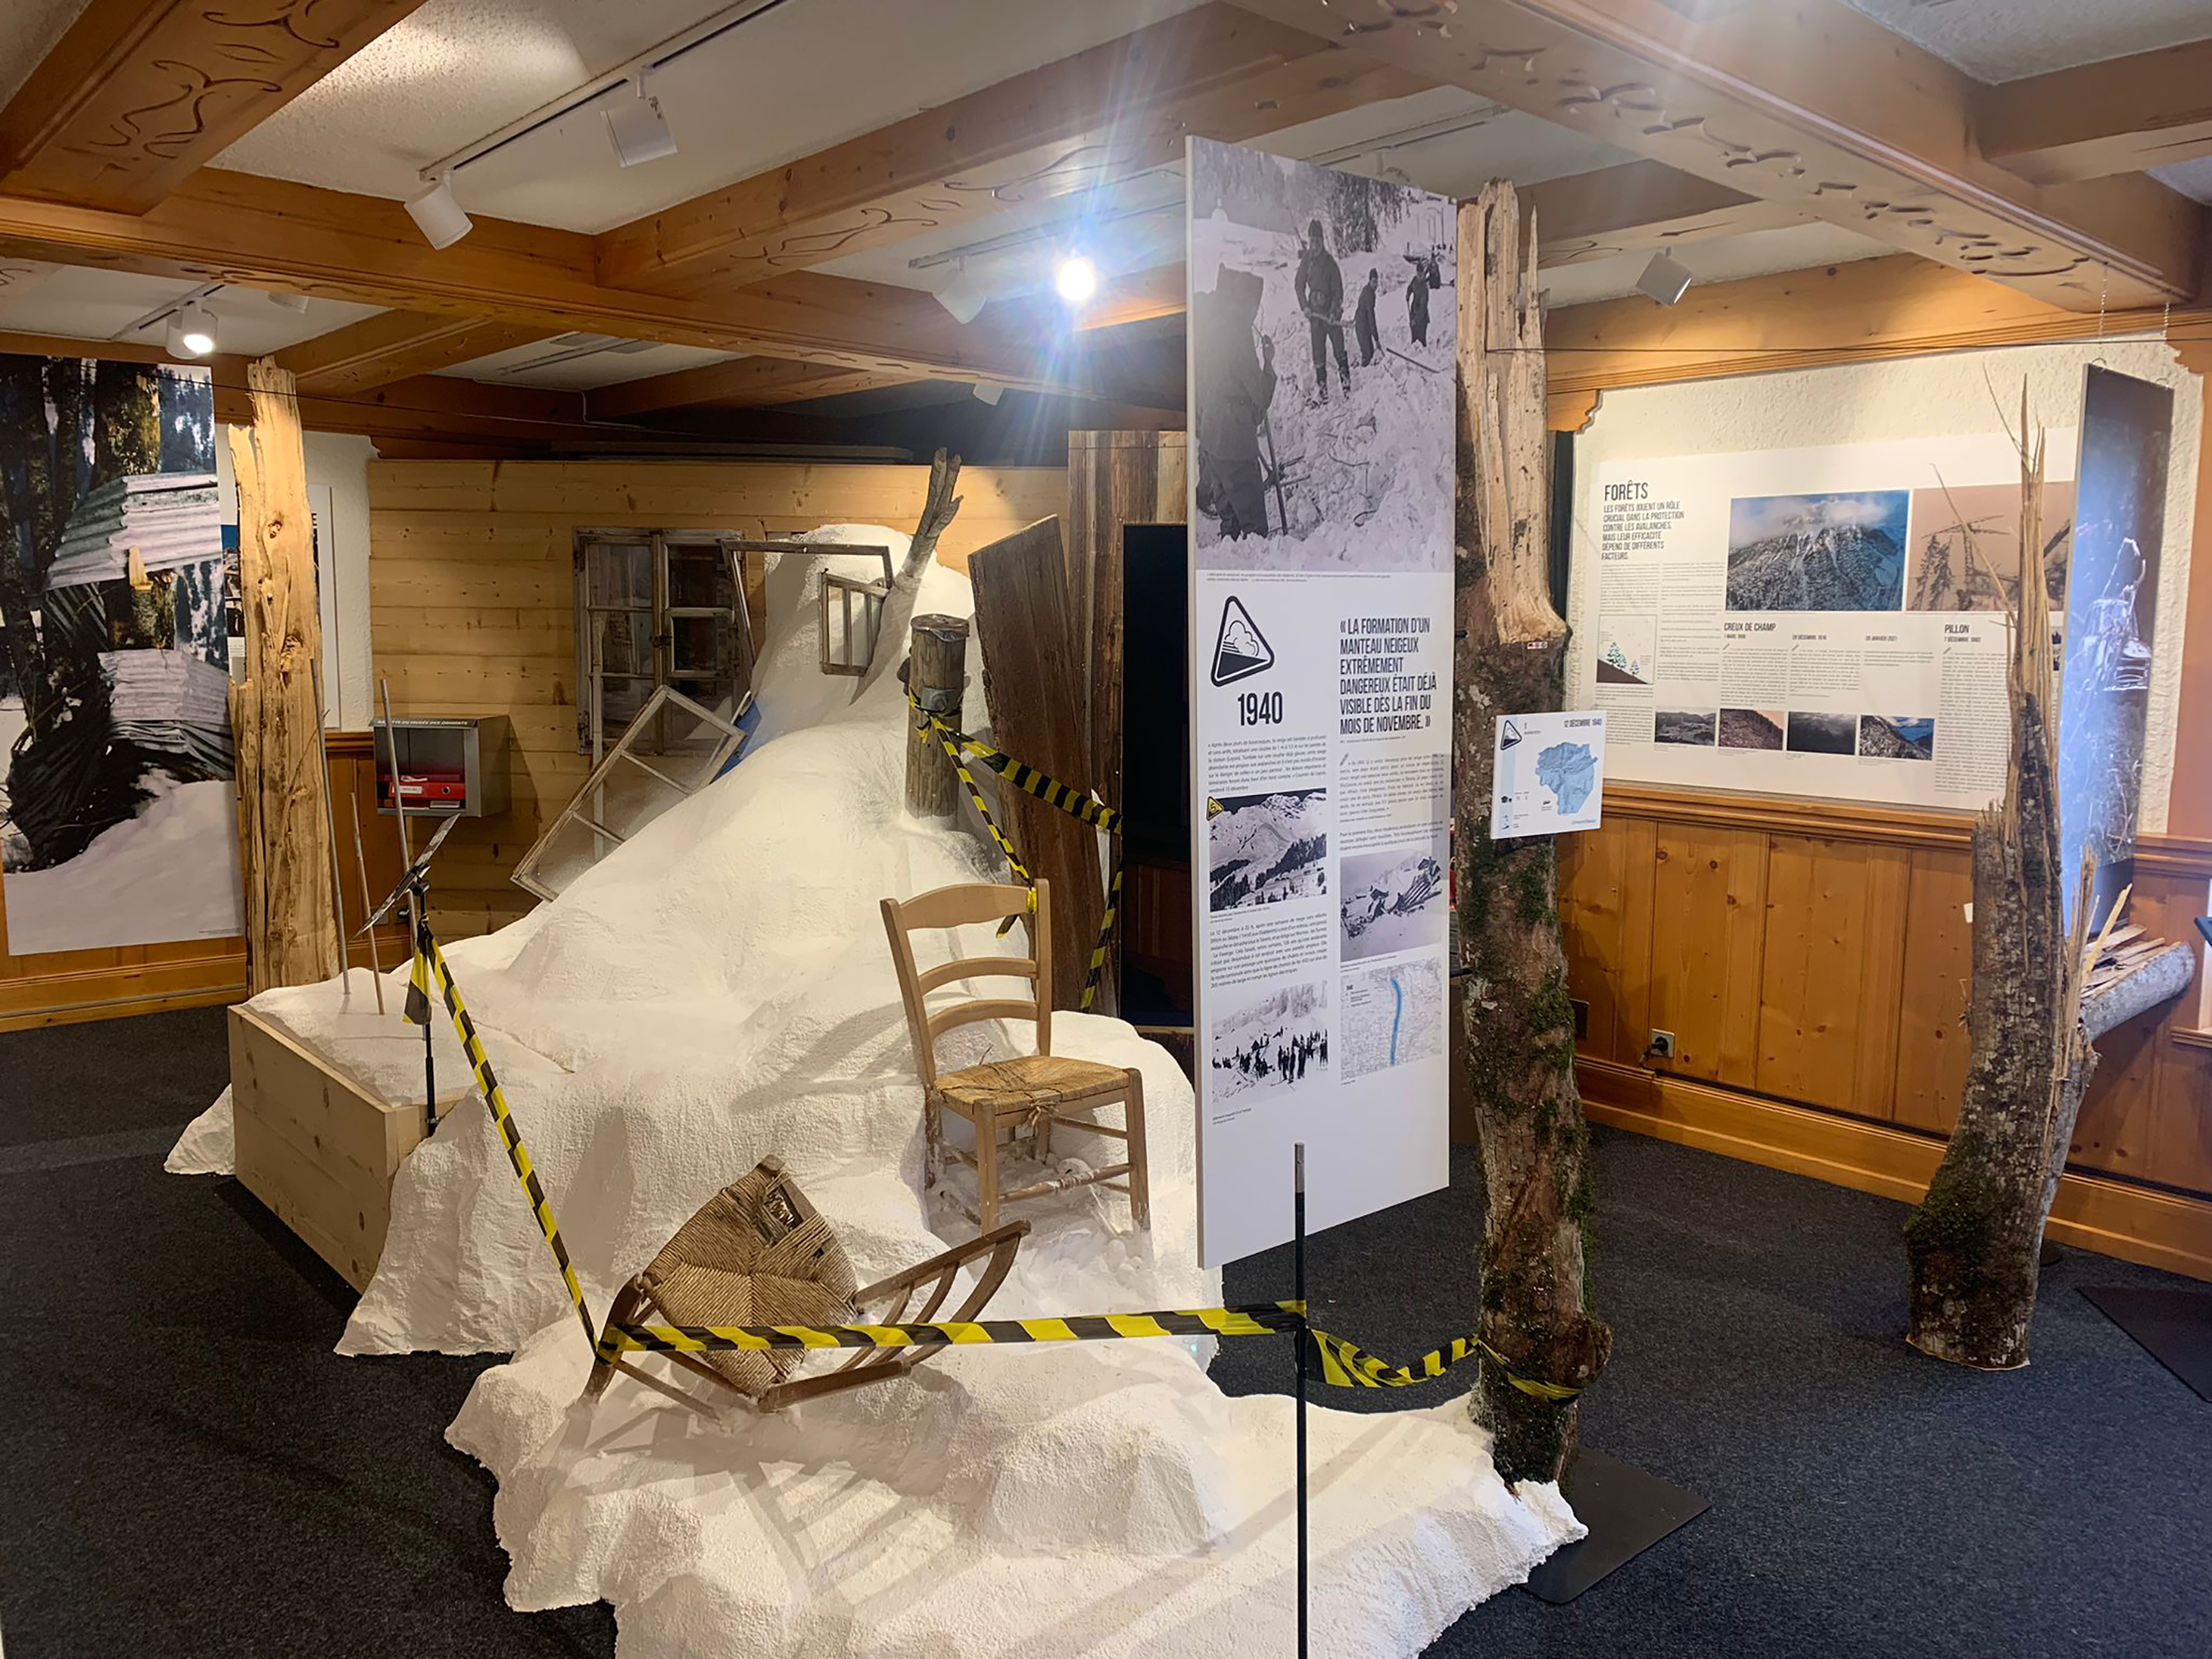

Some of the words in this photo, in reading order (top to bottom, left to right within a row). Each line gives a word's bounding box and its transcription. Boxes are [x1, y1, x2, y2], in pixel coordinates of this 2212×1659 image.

[1604, 480, 1648, 501] FORÊTS
[1603, 505, 1614, 513] LES
[1615, 503, 1635, 512] FORÊTS
[1636, 503, 1656, 511] JOUENT
[1657, 502, 1665, 510] UN
[1666, 500, 1680, 509] RÔLE
[1603, 513, 1625, 522] CRUCIAL
[1642, 512, 1650, 521] LA
[1651, 511, 1685, 520] PROTECTION
[1602, 523, 1624, 532] CONTRE
[1631, 531, 1661, 539] EFFICACITÉ
[1601, 541, 1622, 551] DÉPEND
[1631, 541, 1664, 550] DIFFÉRENTS
[1348, 620, 1359, 635] LA
[1362, 618, 1408, 634] FORMATION
[1410, 617, 1430, 632] D'UN
[1724, 623, 1743, 631] CREUX
[1745, 623, 1752, 631] DE
[1754, 623, 1776, 631] CHAMP
[1944, 624, 1969, 634] PILLON
[1340, 639, 1381, 654] MANTEAU
[1384, 638, 1419, 653] NEIGEUX
[1340, 655, 1403, 675] EXTRÊMEMENT
[1340, 677, 1390, 695] DANGEREUX
[1393, 674, 1414, 692] ÉTAIT
[1417, 675, 1437, 691] DÉJÀ
[1238, 691, 1283, 727] 1940
[1340, 698, 1371, 714] VISIBLE
[1374, 695, 1390, 712] DÈS
[1392, 697, 1403, 712] LA
[1405, 696, 1418, 711] FIN
[1421, 695, 1431, 710] DU
[1340, 718, 1361, 735] MOIS
[1364, 717, 1374, 733] DE
[1377, 715, 1423, 732] NOVEMBRE.
